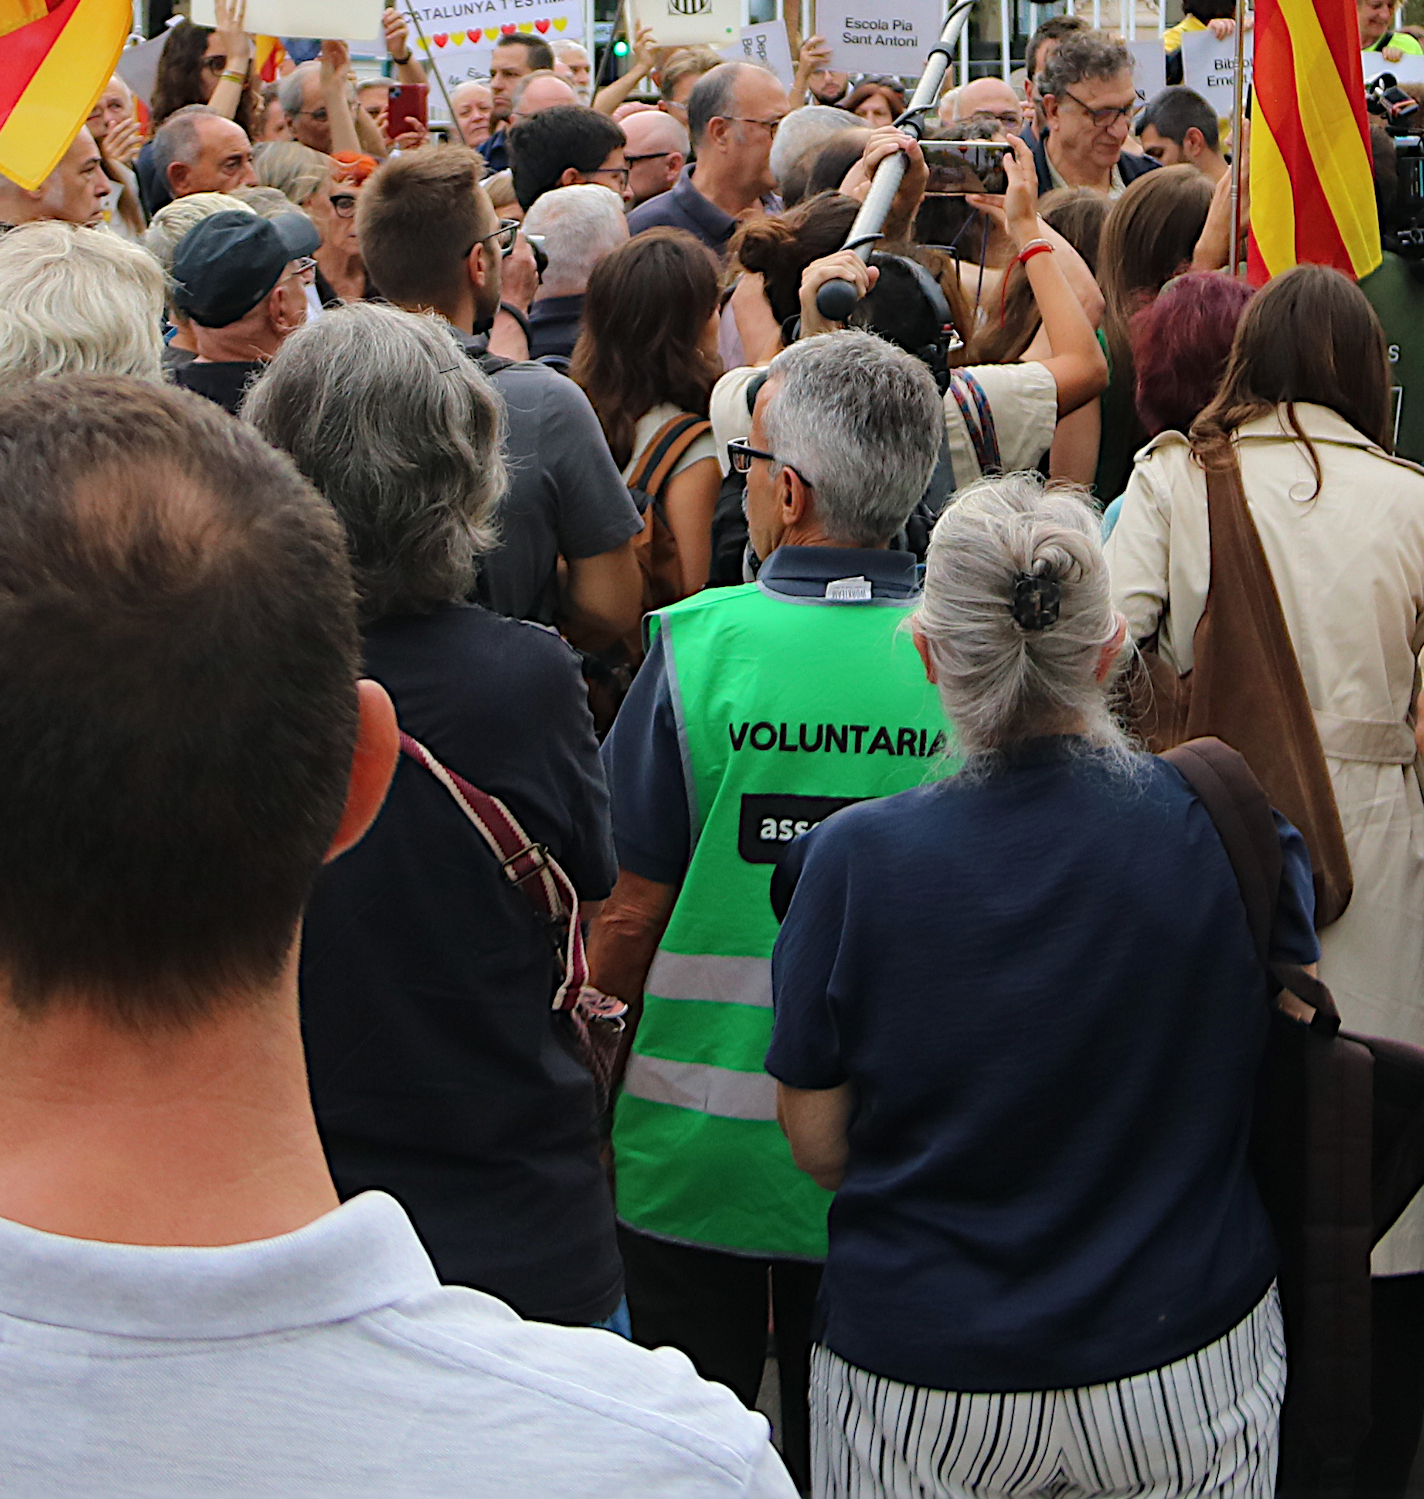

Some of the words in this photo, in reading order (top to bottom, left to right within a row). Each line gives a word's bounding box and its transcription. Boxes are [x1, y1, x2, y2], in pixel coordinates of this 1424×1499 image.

[403, 0, 496, 23] CATALUNYA
[845, 17, 890, 31] Escola
[892, 19, 913, 32] Pia
[756, 34, 768, 62] Dep
[842, 32, 872, 45] Sant
[875, 34, 918, 48] Antoni
